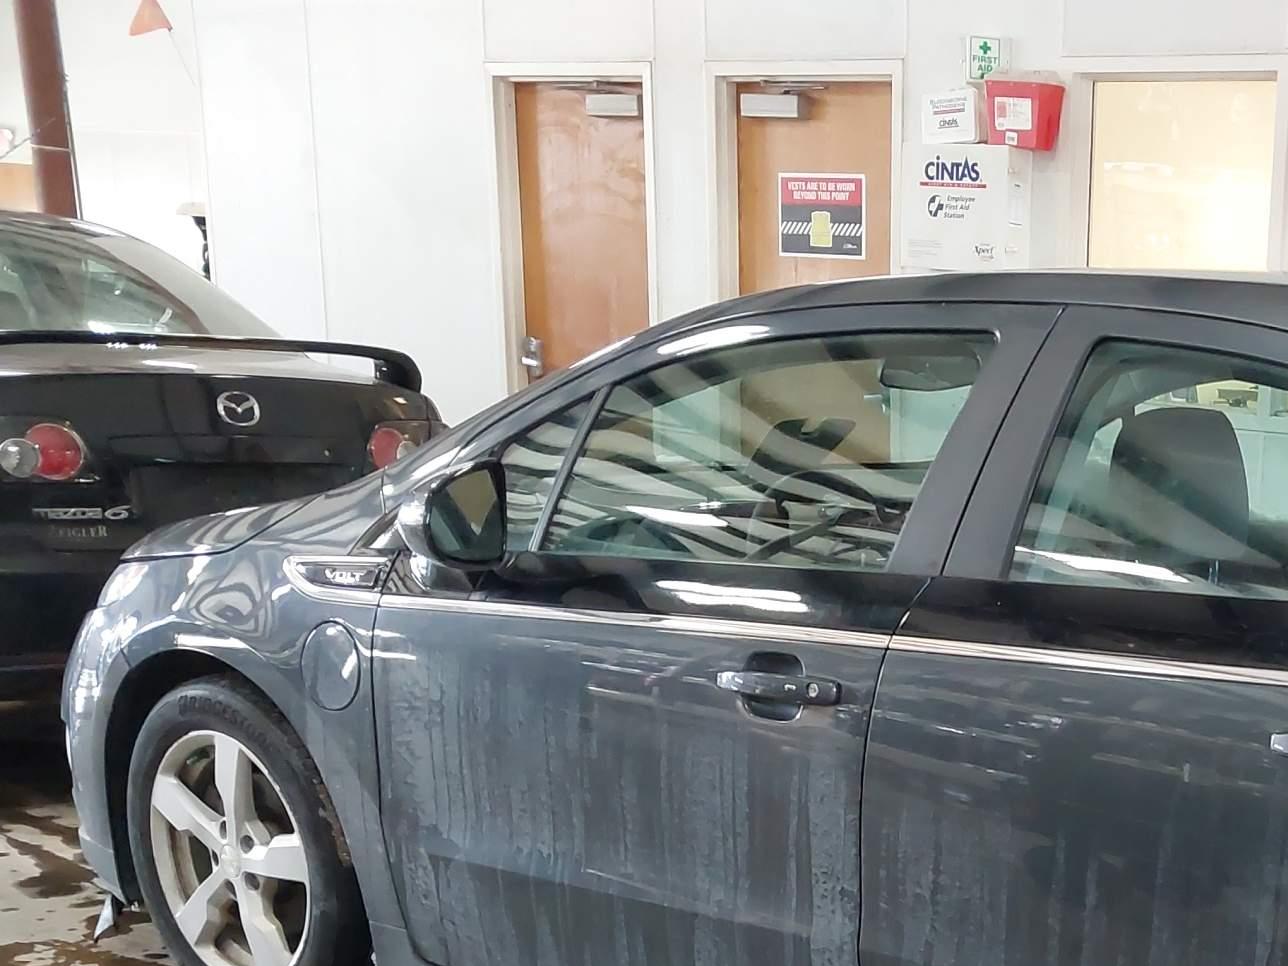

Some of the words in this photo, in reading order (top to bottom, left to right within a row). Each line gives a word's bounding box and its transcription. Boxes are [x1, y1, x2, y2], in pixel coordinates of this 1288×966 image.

[972, 54, 998, 65] FIRST
[977, 64, 993, 72] AID
[787, 181, 806, 190] VESTS
[806, 181, 818, 191] ARE
[819, 182, 827, 191] TO
[828, 182, 836, 191] BE
[836, 182, 856, 192] WORN
[793, 191, 817, 200] BEYOND
[817, 191, 831, 200] THIS
[831, 192, 850, 201] POINT
[946, 195, 976, 204] Employee
[959, 203, 970, 211] Aid
[324, 567, 367, 582] VOLT
